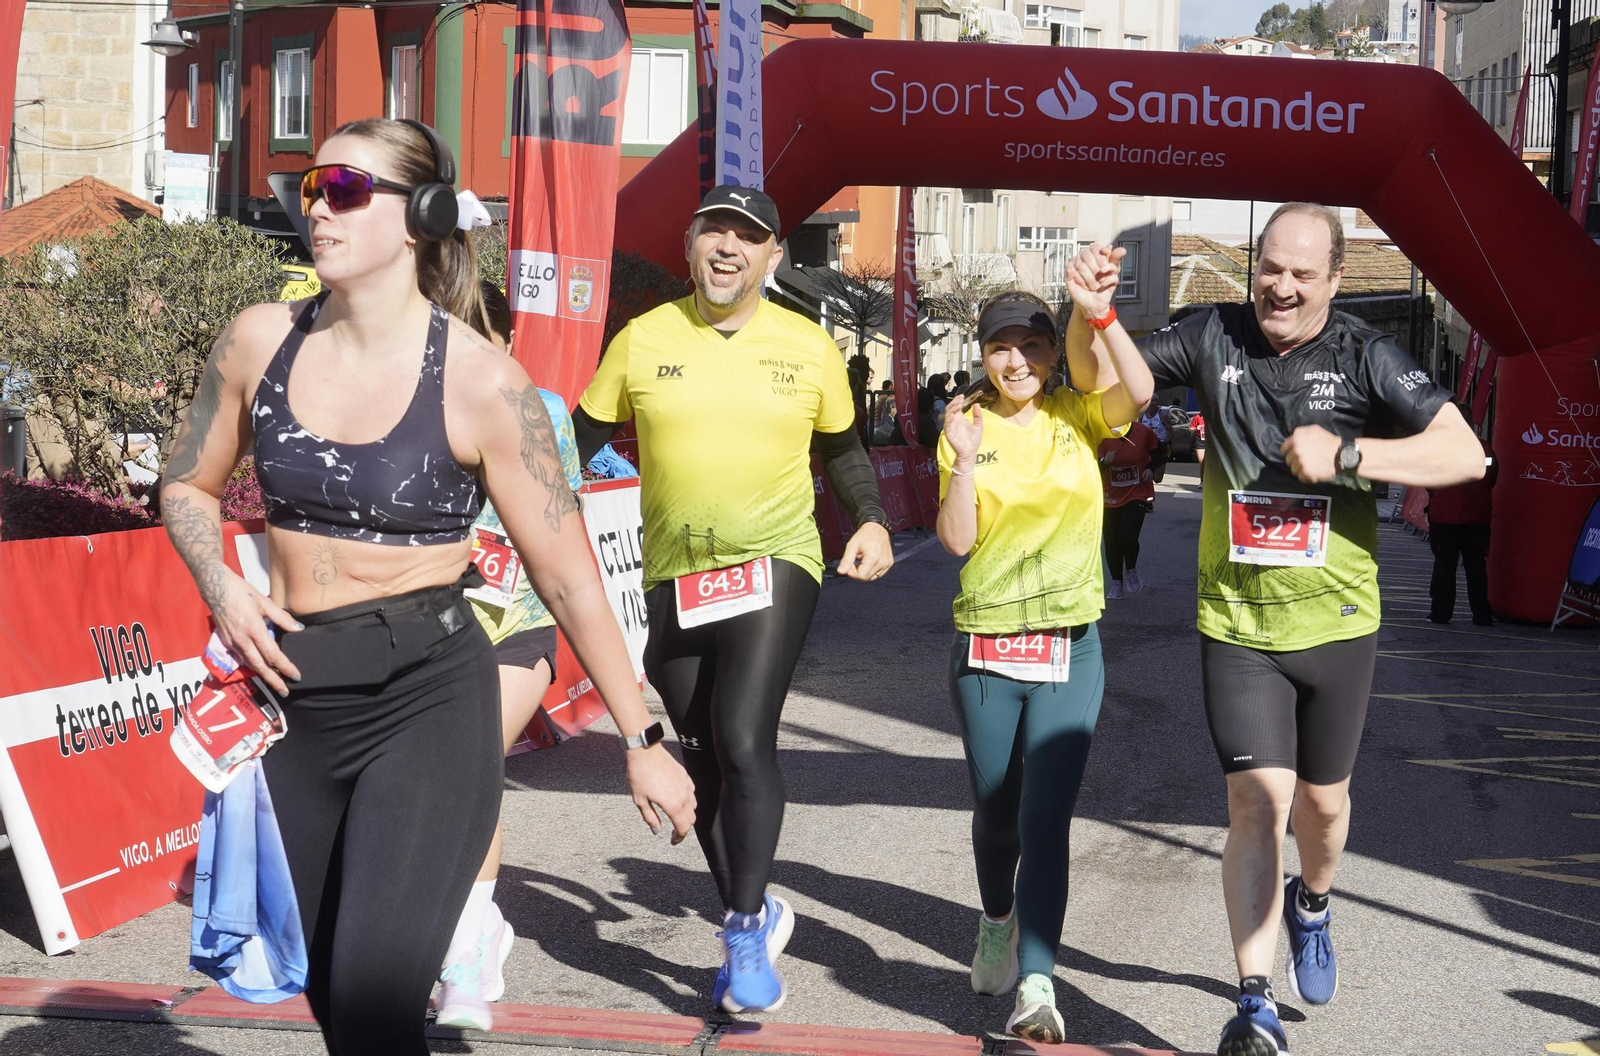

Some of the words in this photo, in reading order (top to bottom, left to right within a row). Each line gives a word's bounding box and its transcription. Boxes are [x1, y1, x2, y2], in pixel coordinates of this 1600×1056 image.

[869, 70, 1025, 126] Sports
[1107, 80, 1365, 134] Santander
[1003, 140, 1226, 168] sportssantander.es
[657, 364, 686, 378] DK
[771, 371, 795, 385] 2M
[771, 386, 798, 397] VIGO
[1310, 384, 1335, 396] 2M
[1308, 400, 1336, 410] VIGO
[975, 450, 998, 465] DK
[1251, 514, 1302, 541] 522
[698, 567, 746, 597] 643
[89, 622, 164, 685] VIGO,
[995, 632, 1045, 655] 644
[56, 703, 130, 757] terreo
[131, 682, 163, 737] de
[195, 689, 247, 733] 17
[120, 841, 153, 869] VIGO,
[155, 836, 165, 858] A
